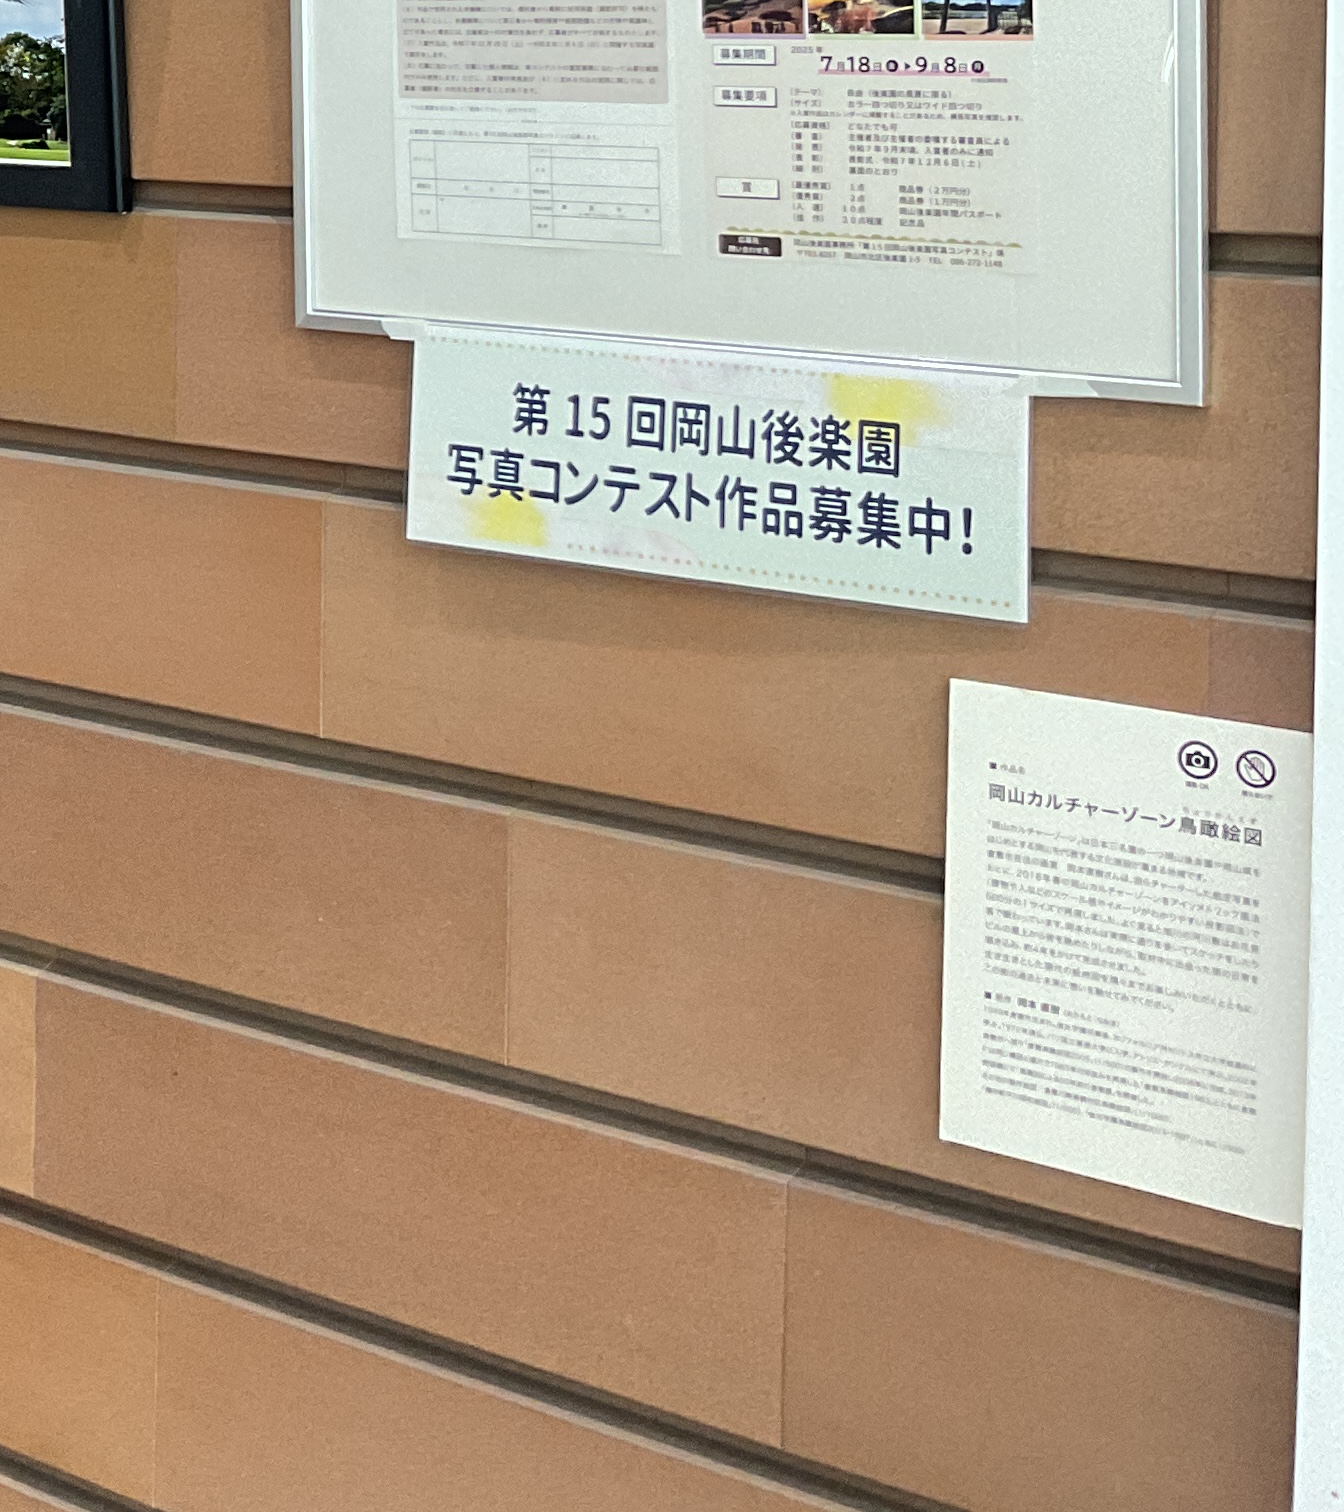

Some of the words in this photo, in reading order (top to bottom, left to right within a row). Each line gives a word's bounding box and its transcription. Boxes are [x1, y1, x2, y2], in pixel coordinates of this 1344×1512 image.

[446, 442, 975, 557] 写真コンテスト作品募集中!
